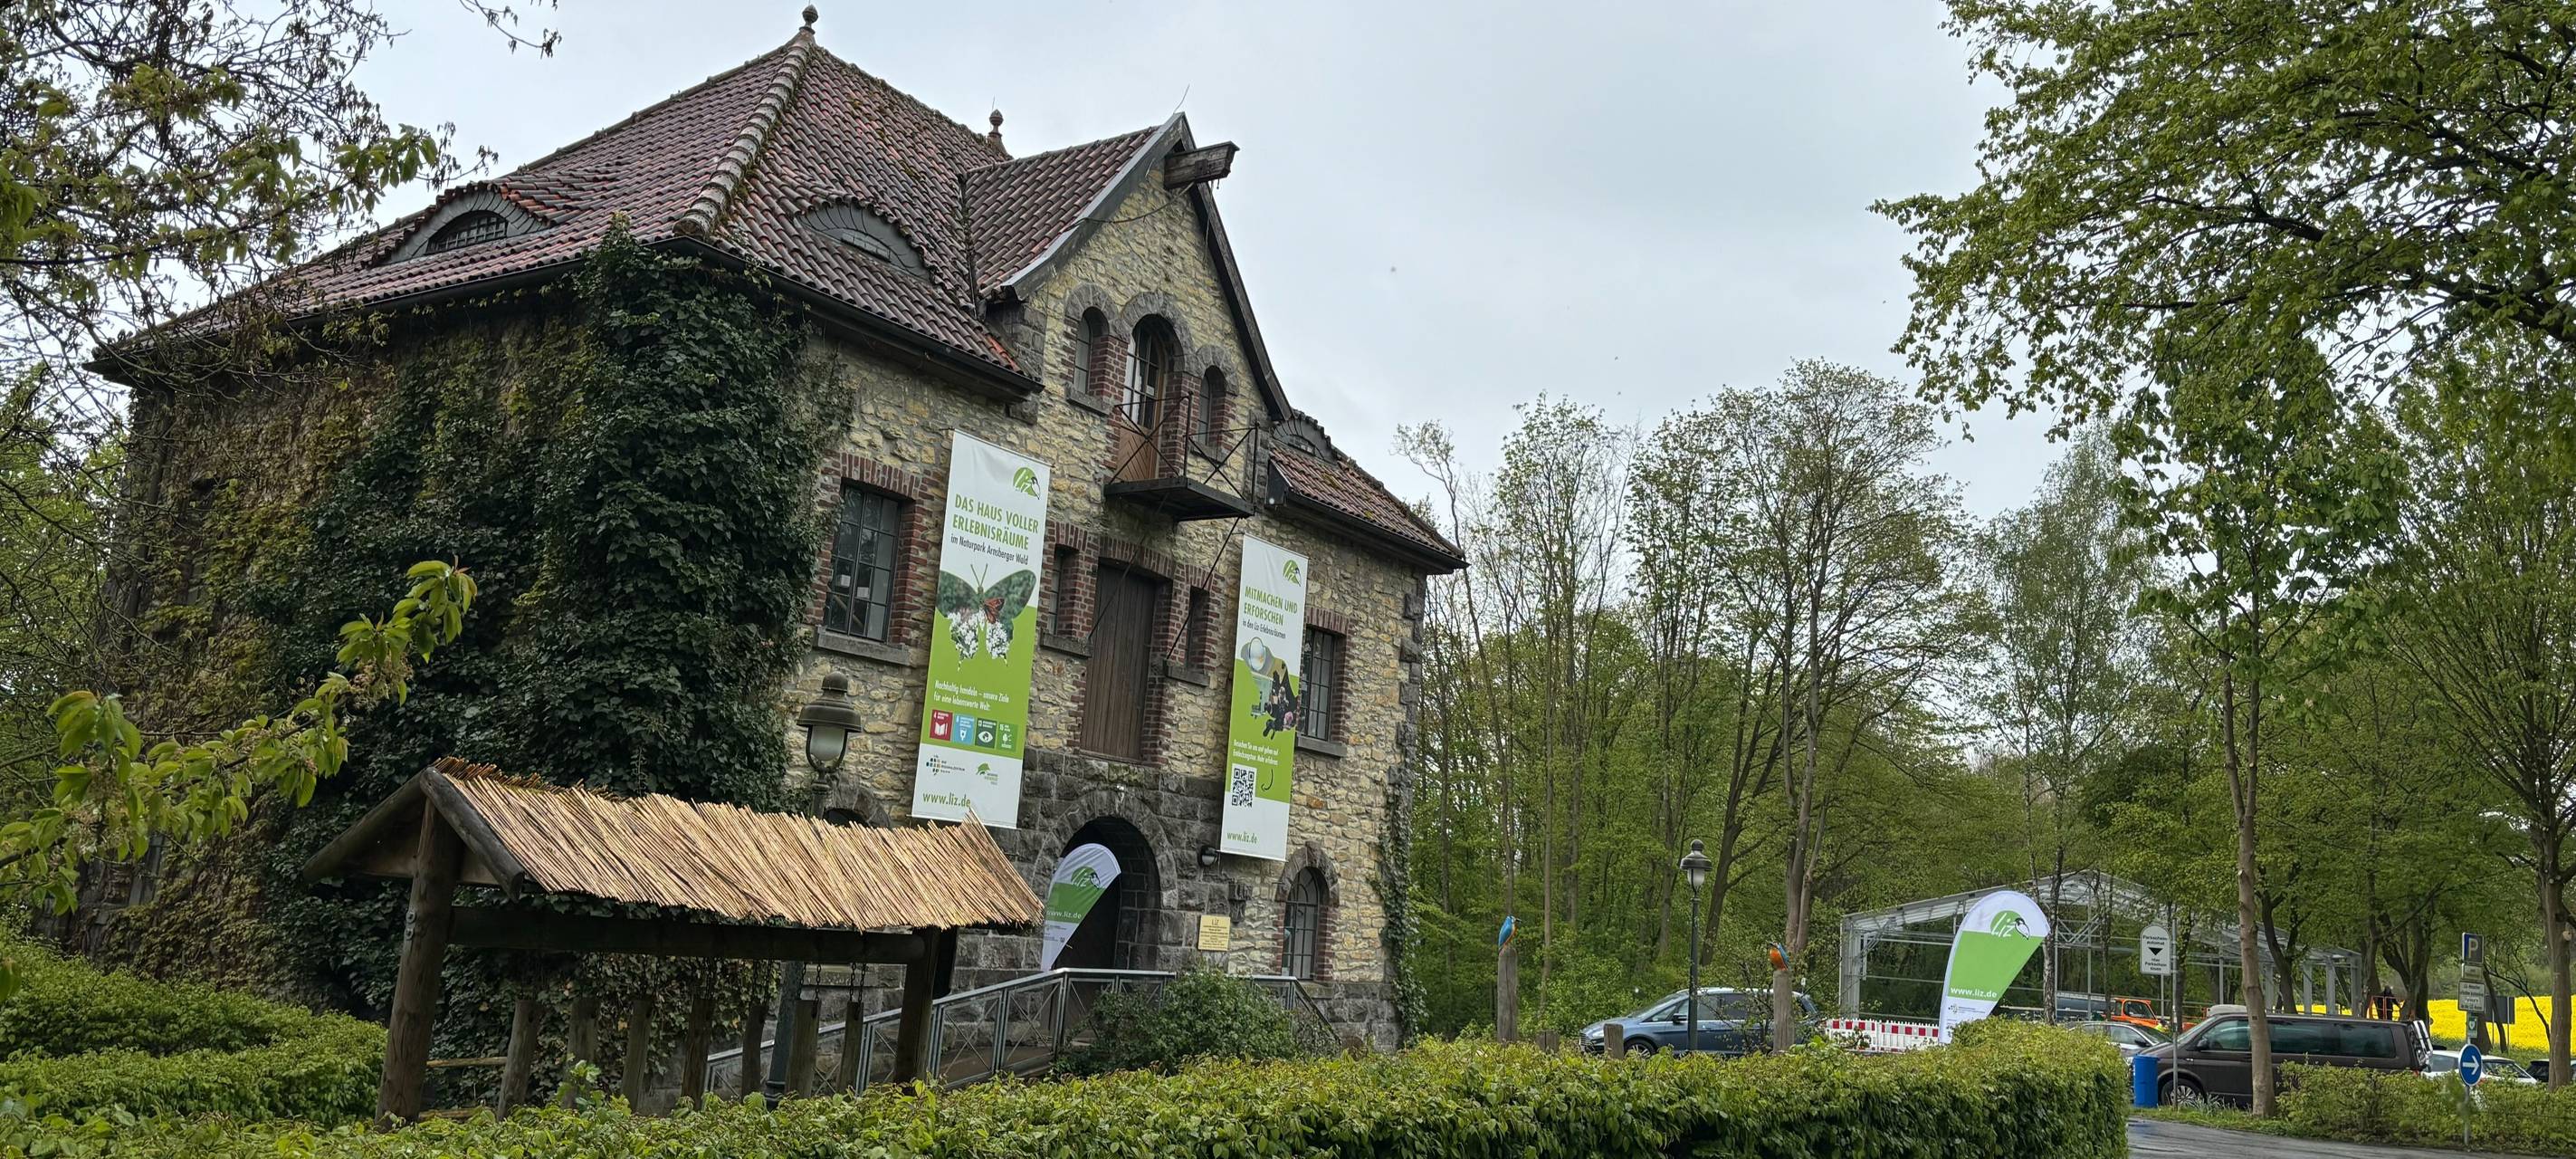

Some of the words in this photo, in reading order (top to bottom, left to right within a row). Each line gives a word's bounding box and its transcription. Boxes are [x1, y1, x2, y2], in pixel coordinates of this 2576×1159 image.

[955, 493, 974, 512] DAS
[977, 502, 1002, 522] HAUS
[1006, 511, 1039, 533] VOLLER
[952, 514, 1029, 550] ERLEBNISRÄUME
[950, 533, 958, 544] im
[959, 536, 986, 552] Naturpark
[987, 545, 1015, 562] Arnsberger
[1016, 553, 1028, 565] Wald
[1245, 586, 1283, 609] MITMACHEN
[1284, 599, 1298, 614] UND
[1244, 602, 1284, 626] ERFORSCHEN
[935, 680, 959, 695] Nachhaltig
[959, 685, 978, 696] handeln
[922, 792, 971, 808] www.liz.de
[1226, 830, 1257, 844] www.liz.de
[2468, 937, 2478, 958] P
[1950, 987, 1998, 998] www.liz.de
